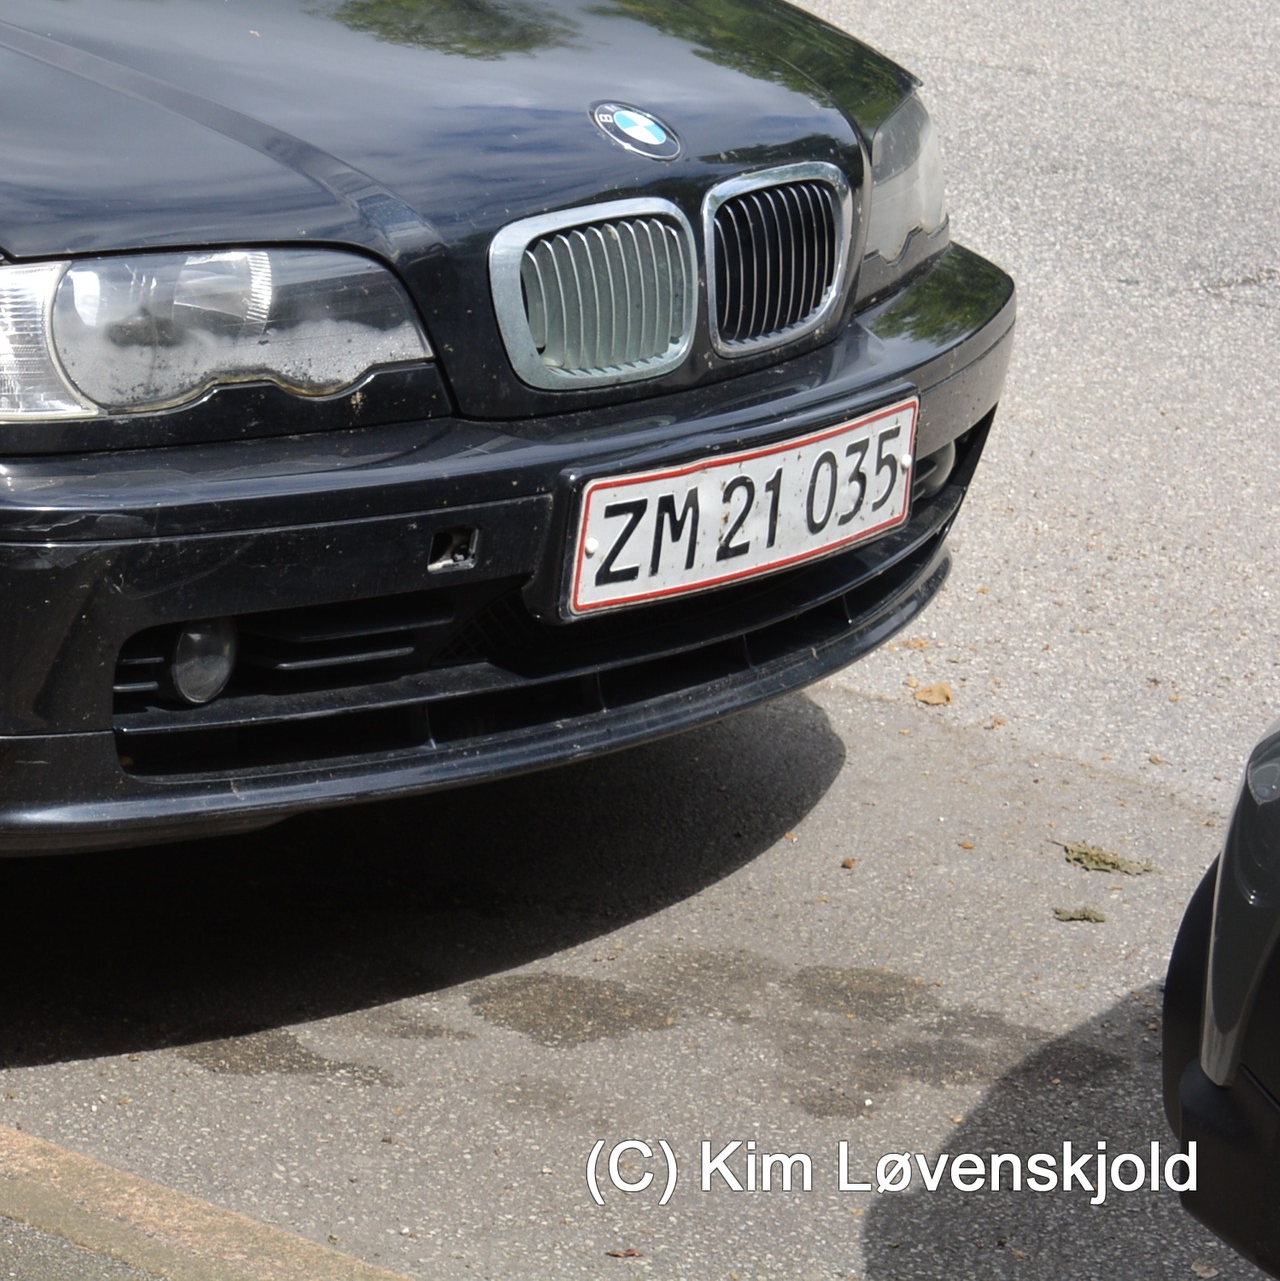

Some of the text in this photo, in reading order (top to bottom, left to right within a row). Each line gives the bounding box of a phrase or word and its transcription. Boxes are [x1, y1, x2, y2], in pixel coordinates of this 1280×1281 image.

[595, 425, 901, 586] ZM 21 035
